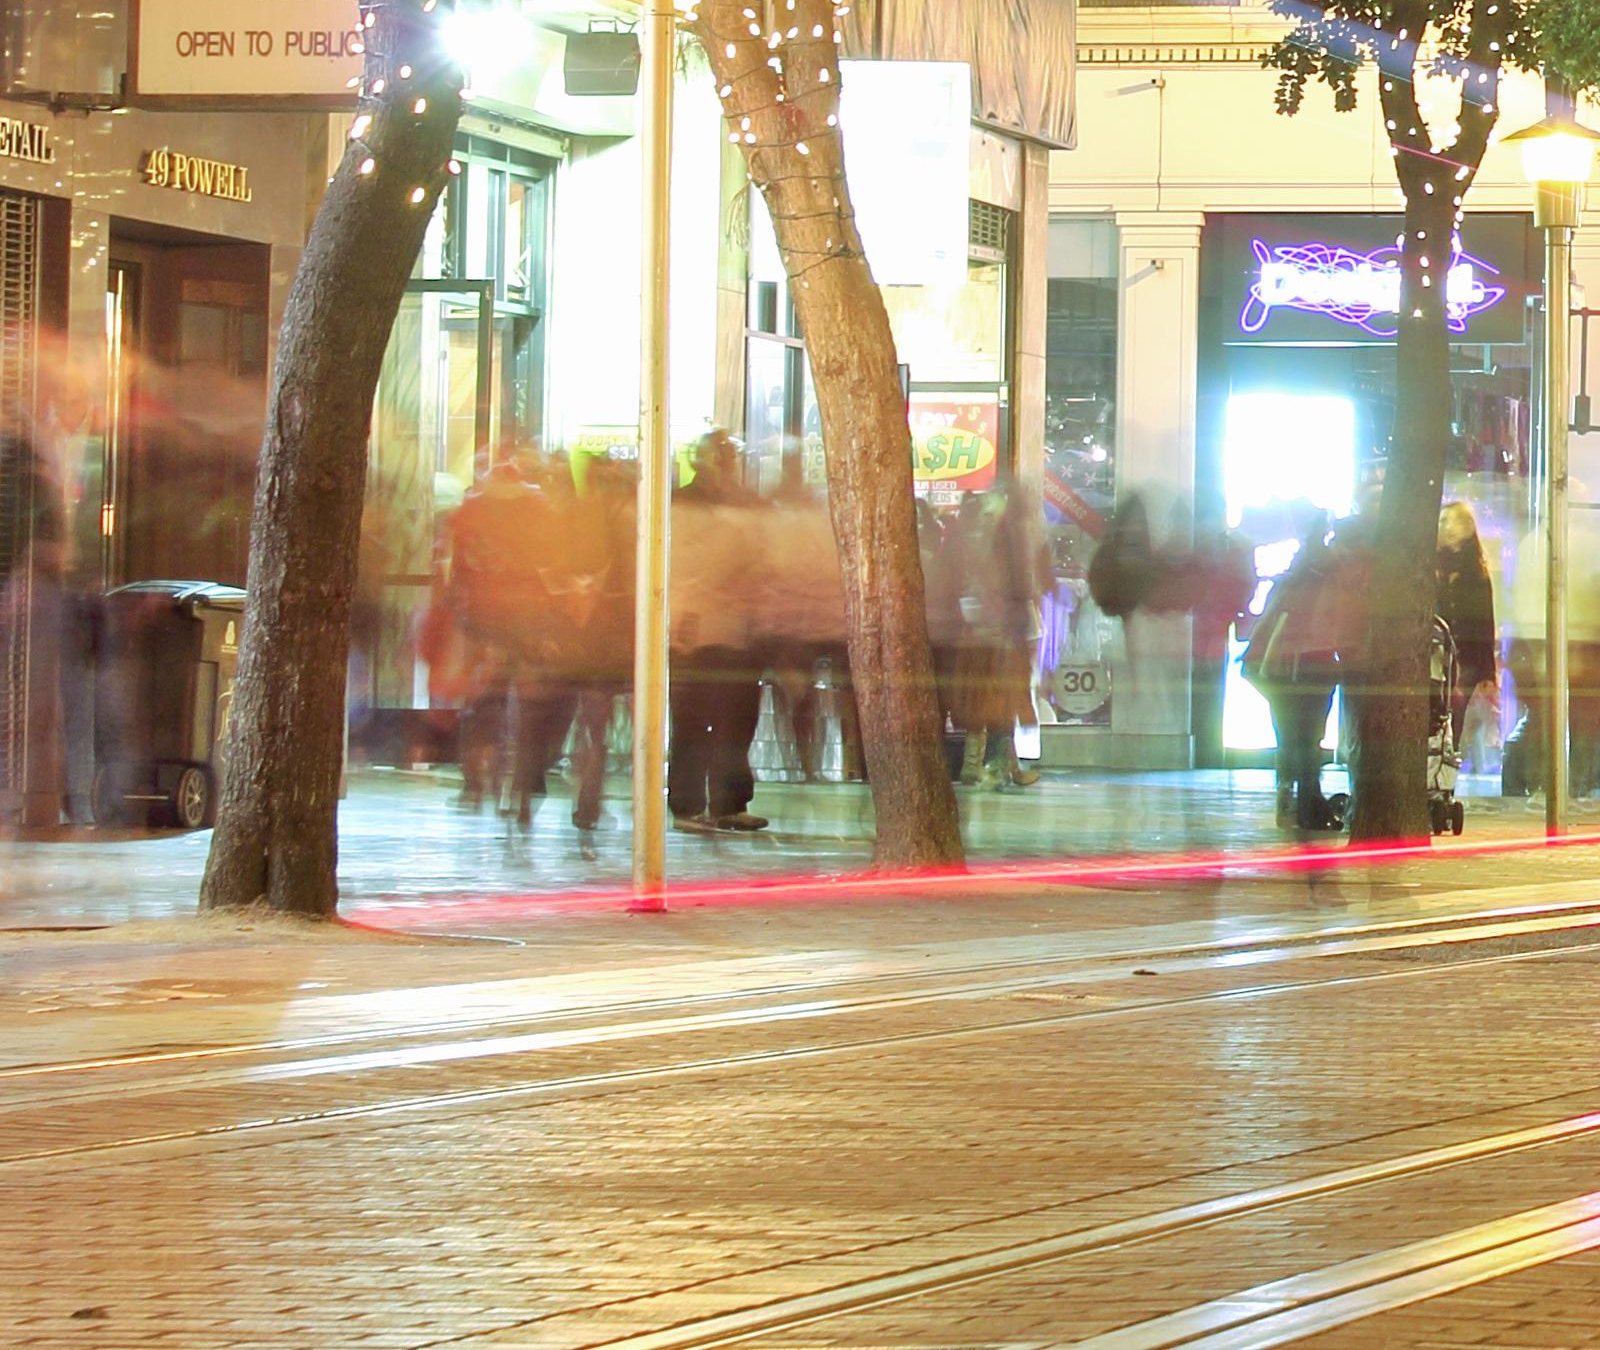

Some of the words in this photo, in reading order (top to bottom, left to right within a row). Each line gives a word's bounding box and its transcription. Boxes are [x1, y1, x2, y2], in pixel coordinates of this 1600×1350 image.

[176, 30, 236, 57] OPEN
[245, 30, 273, 57] TO
[285, 30, 361, 57] PUBLIC
[0, 117, 55, 164] ETAIL
[145, 149, 169, 186] 49
[172, 152, 252, 202] POWELL
[1063, 671, 1096, 692] 30
